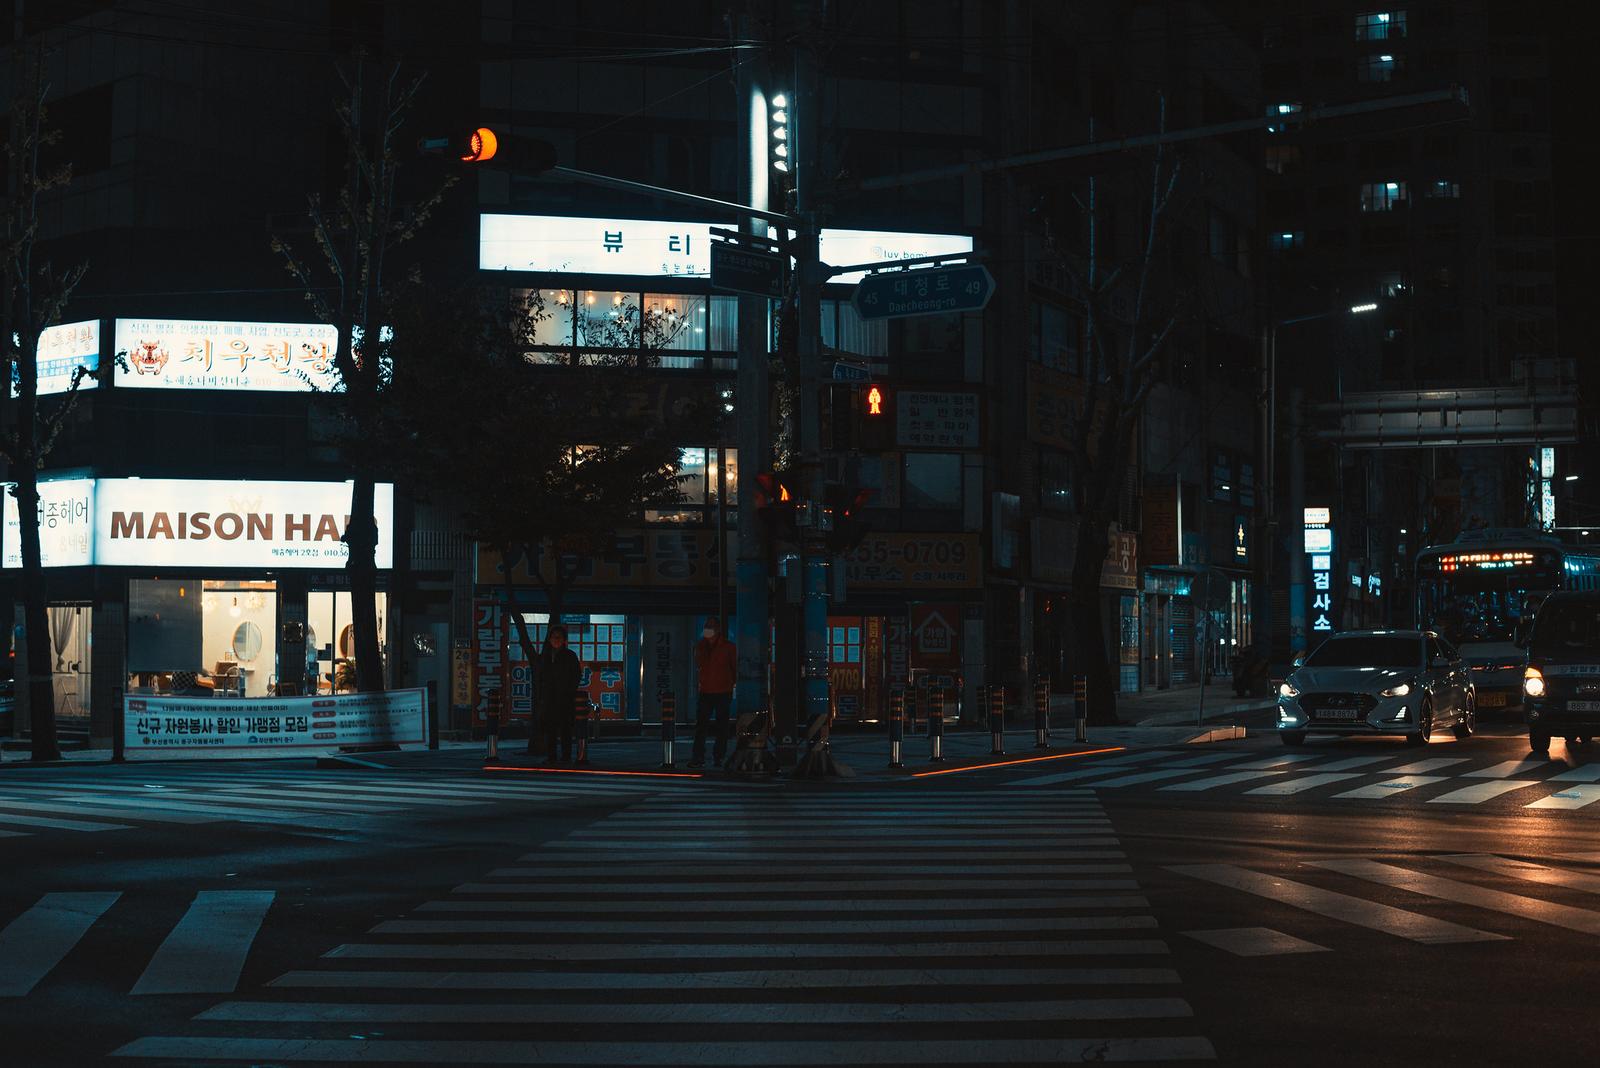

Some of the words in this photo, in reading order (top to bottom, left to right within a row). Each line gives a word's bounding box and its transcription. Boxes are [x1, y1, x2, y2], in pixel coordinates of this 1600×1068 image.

[893, 275, 950, 297] 대청로
[965, 280, 981, 295] 49
[864, 292, 878, 305] 45
[888, 298, 956, 313] Daecheong-ro
[181, 338, 336, 375] 치우천왕
[110, 511, 272, 540] MAISON
[324, 549, 349, 557] 010.56
[1313, 572, 1331, 631] 검사소
[137, 717, 161, 735] 신규
[164, 716, 213, 734] 자원봉사
[217, 716, 241, 734] 할인
[246, 716, 280, 734] 가맹점
[285, 716, 308, 733] 모집
